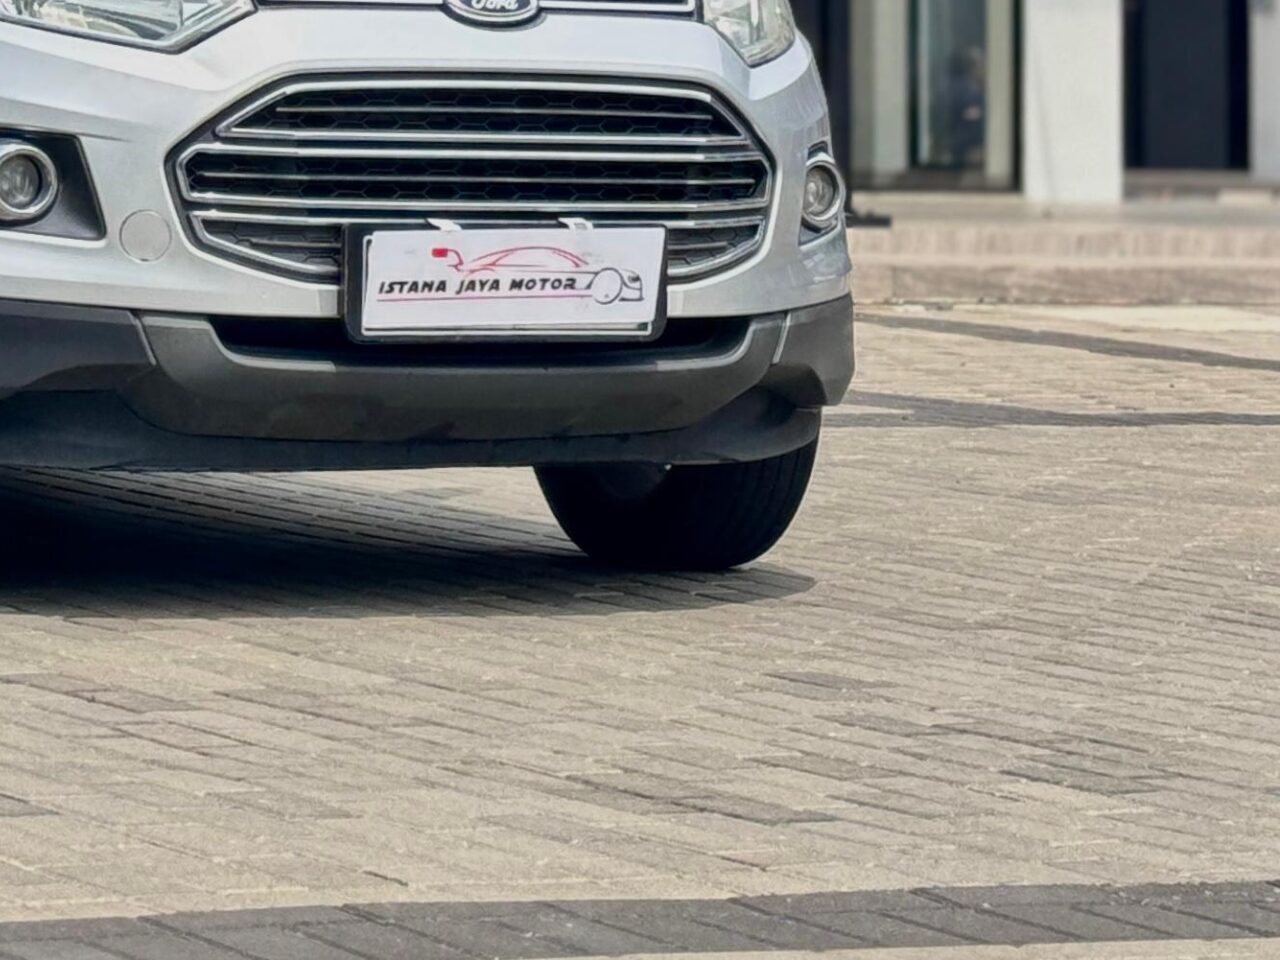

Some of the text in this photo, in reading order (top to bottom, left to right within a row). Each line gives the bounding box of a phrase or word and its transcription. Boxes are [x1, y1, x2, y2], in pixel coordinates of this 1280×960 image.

[378, 277, 578, 295] ISTANA JAYA MOTOR
